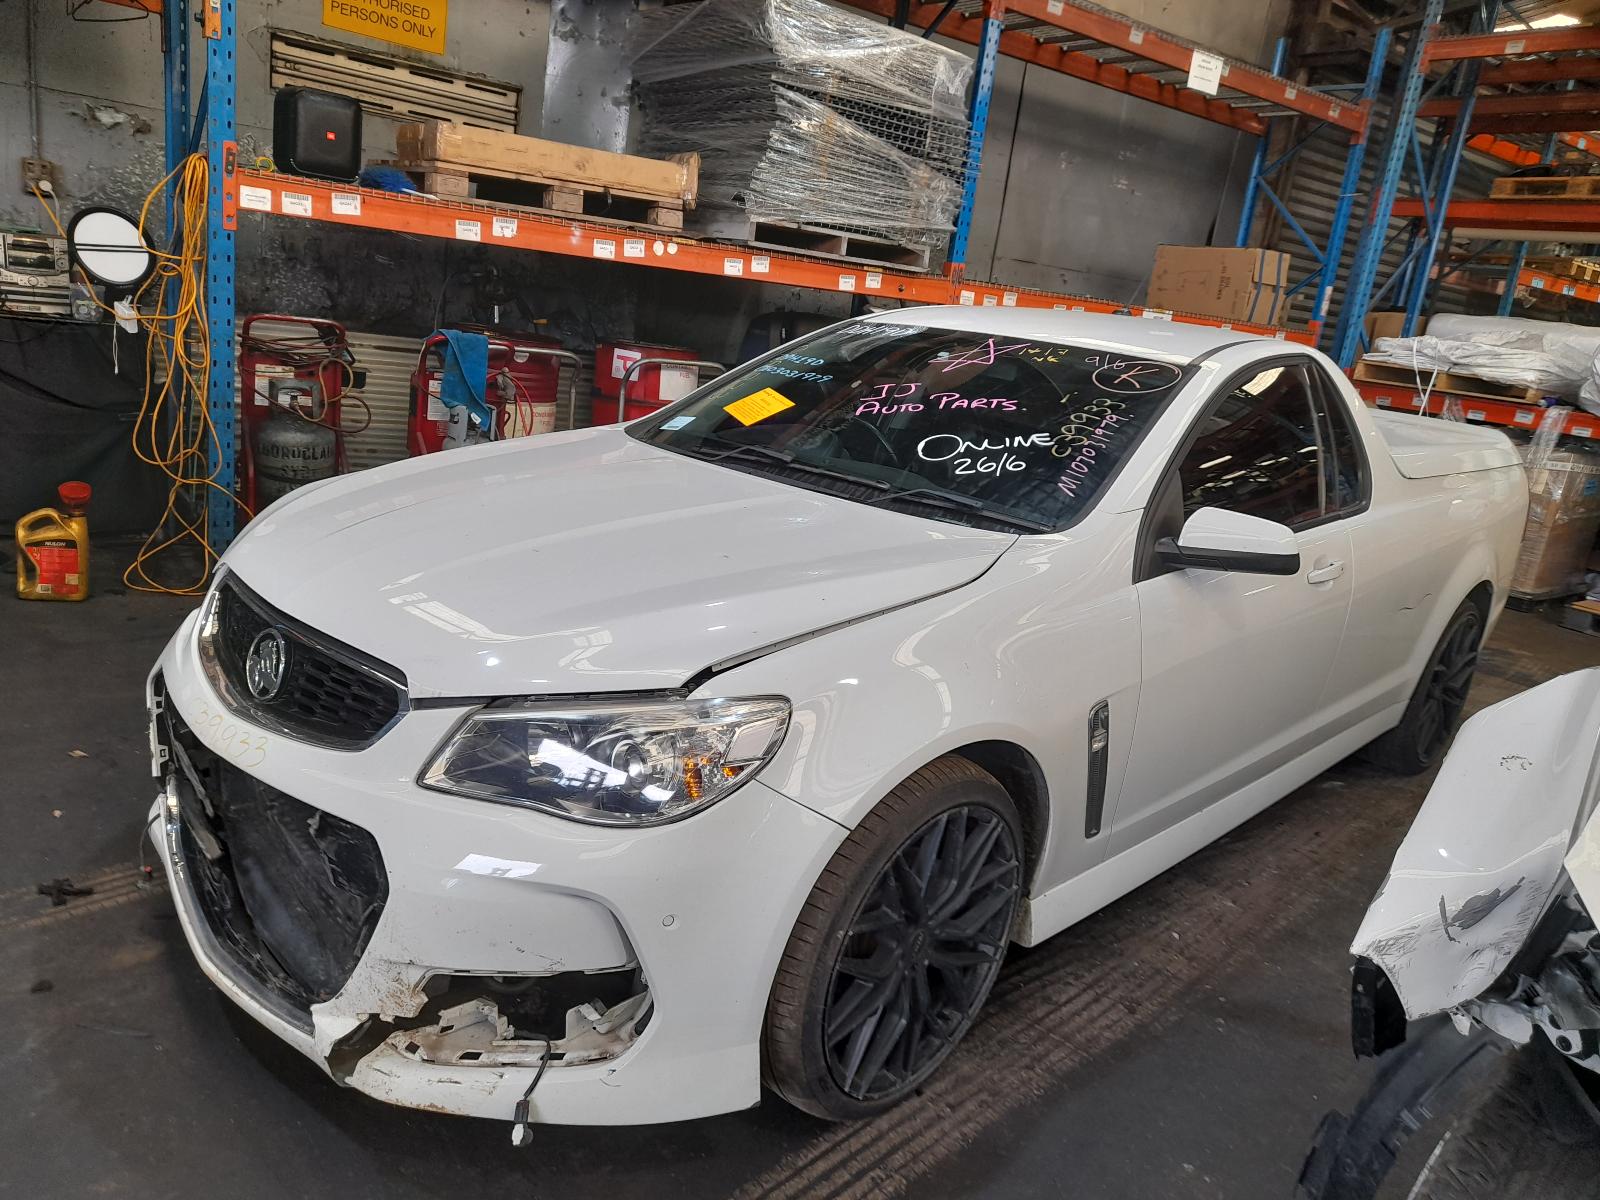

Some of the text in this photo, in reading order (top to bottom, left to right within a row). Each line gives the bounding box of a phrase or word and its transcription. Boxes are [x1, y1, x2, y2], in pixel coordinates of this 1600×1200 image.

[331, 0, 437, 38] PERSONS ONLY
[358, 0, 430, 20] HORISED
[855, 400, 925, 416] AUTO
[917, 432, 1056, 461] ONLINE
[953, 452, 1027, 477] 26/6
